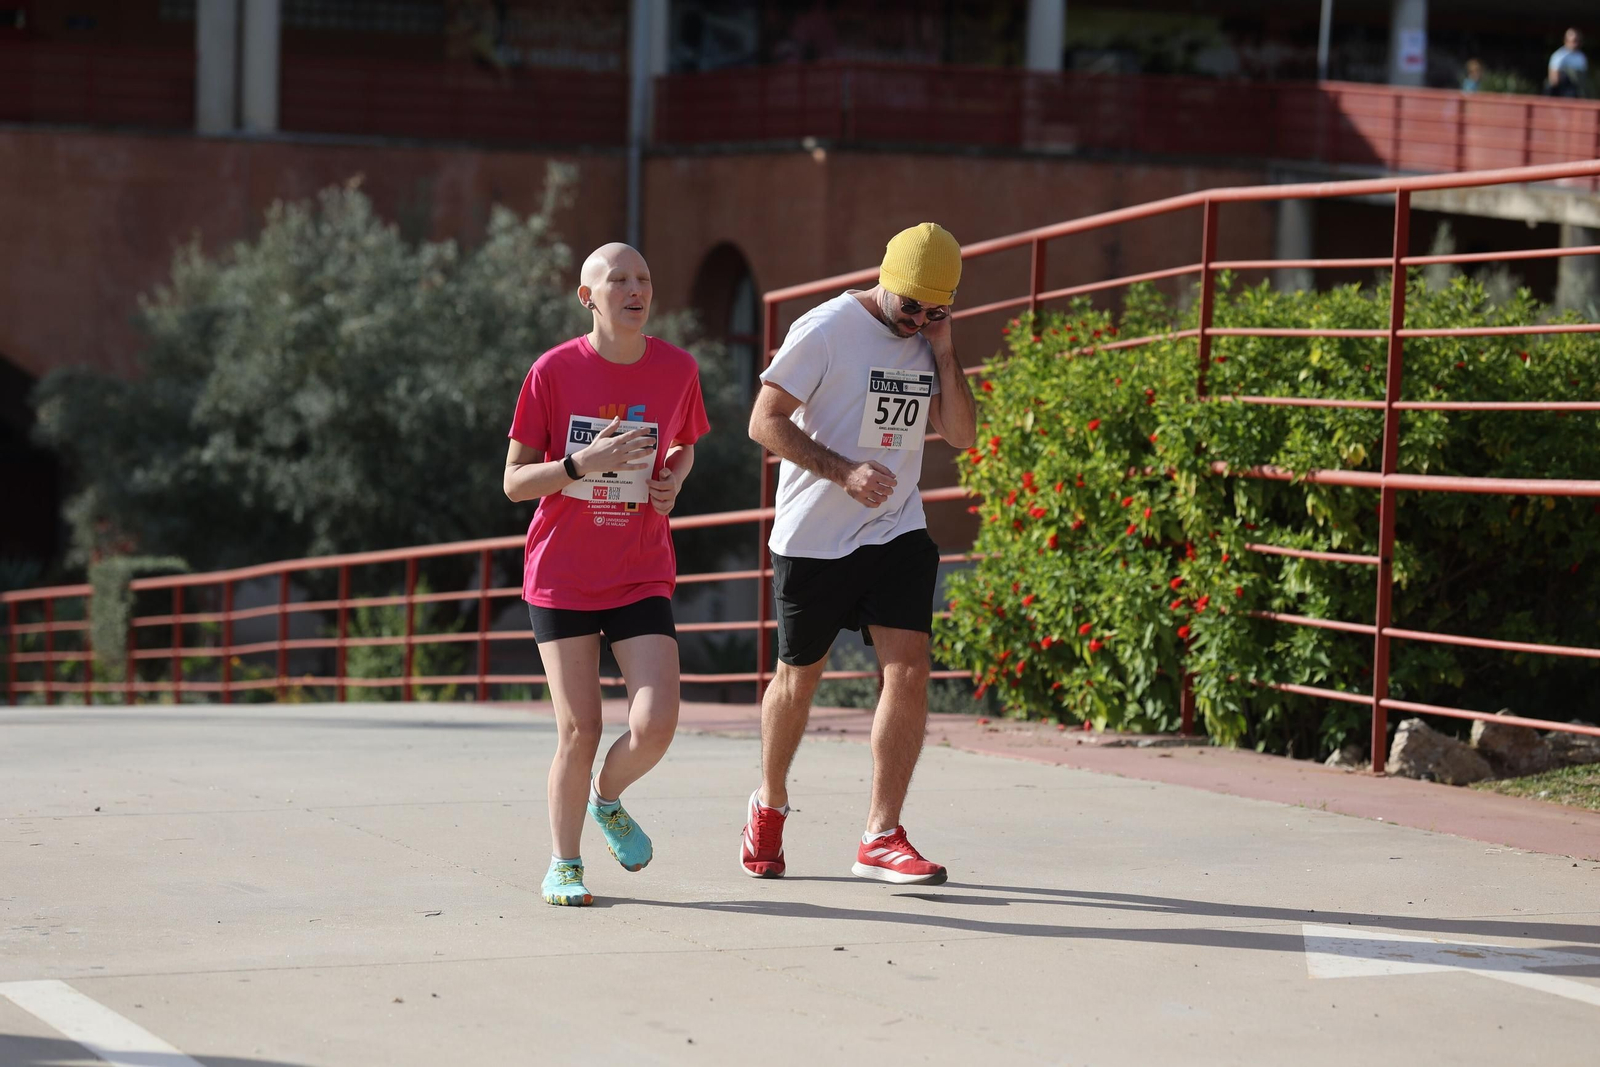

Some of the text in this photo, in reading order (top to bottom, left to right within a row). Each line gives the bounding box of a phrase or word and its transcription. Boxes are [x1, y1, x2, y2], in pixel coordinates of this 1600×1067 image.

[872, 380, 899, 392] UMA
[874, 397, 919, 426] 570
[573, 430, 596, 443] UM
